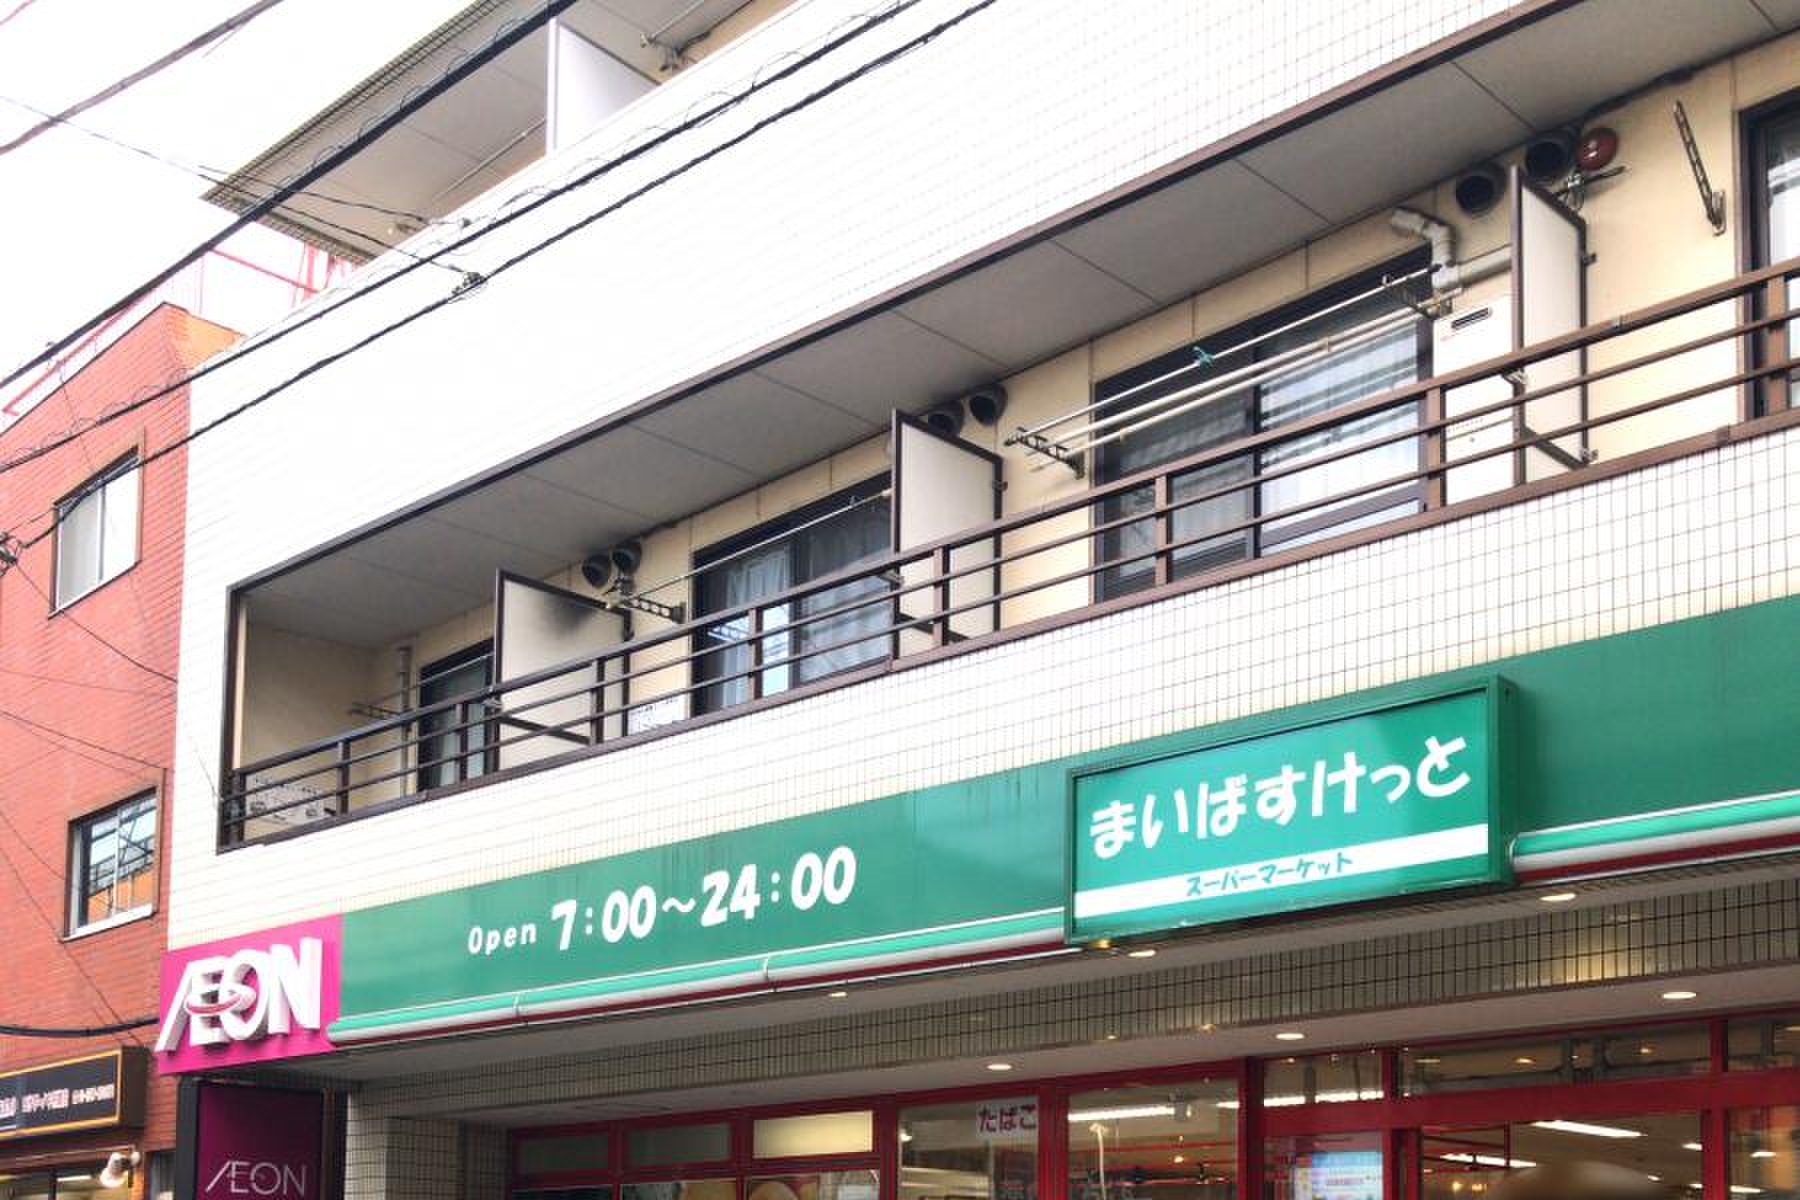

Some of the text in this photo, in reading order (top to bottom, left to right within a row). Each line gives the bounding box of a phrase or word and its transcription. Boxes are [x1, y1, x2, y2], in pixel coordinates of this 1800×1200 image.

[1089, 736, 1471, 859] まいばすけっと
[1186, 852, 1353, 897] スーパーマーケット
[468, 922, 537, 955] Open
[978, 1103, 1037, 1132] たばこ
